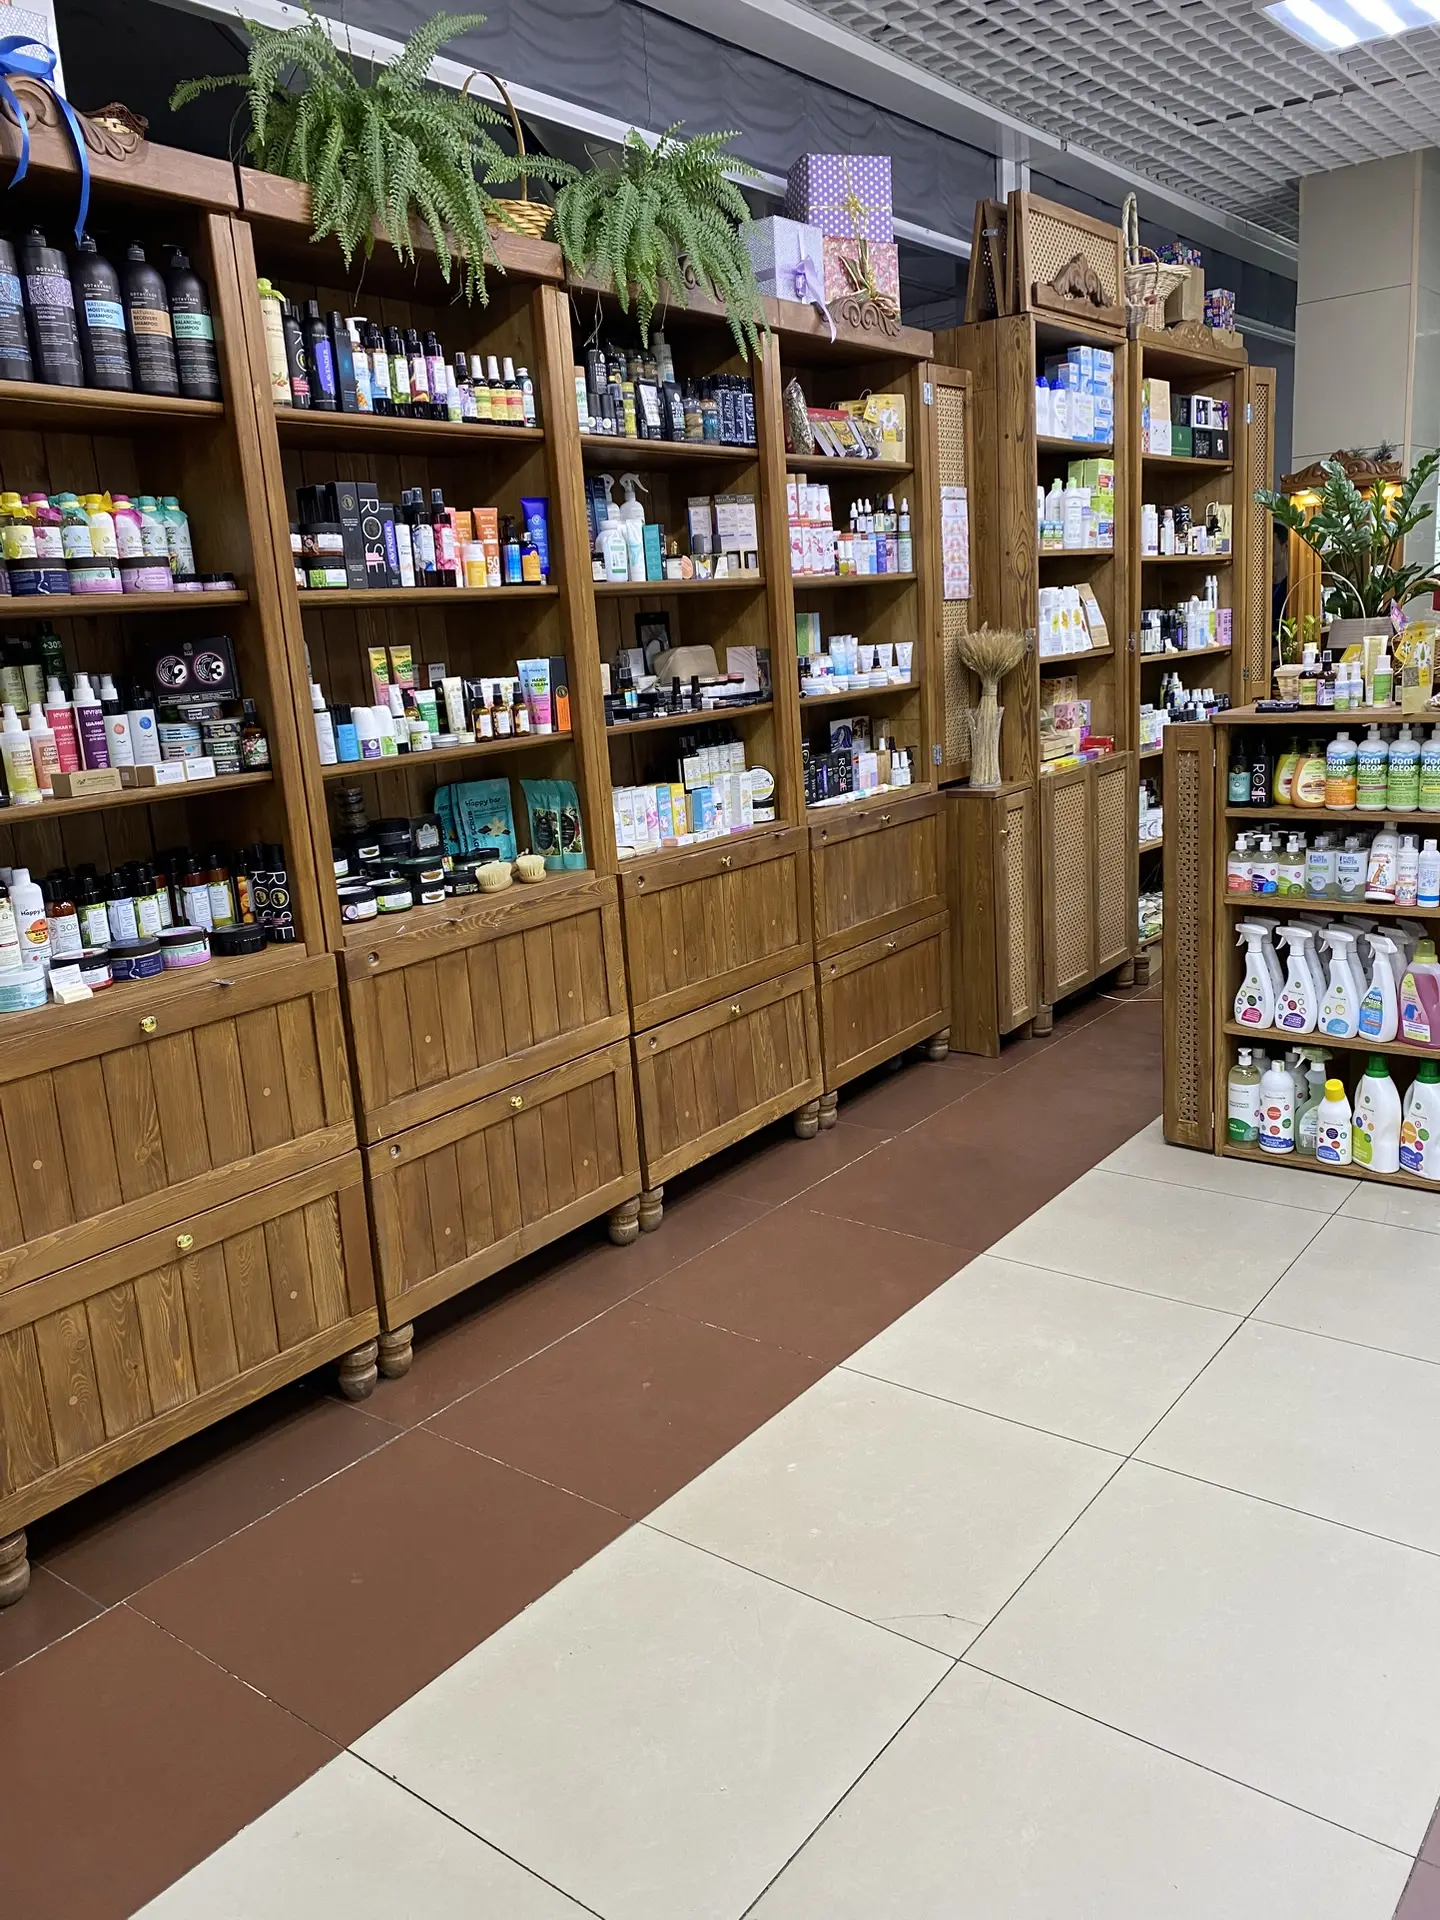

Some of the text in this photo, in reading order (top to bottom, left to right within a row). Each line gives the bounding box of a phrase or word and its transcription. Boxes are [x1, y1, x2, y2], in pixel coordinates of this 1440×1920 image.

[359, 498, 387, 573] ROSE
[386, 526, 396, 567] LAVENDER
[487, 556, 499, 568] 50
[174, 664, 187, 684] 2
[211, 661, 225, 680] 3
[838, 757, 847, 792] ROSE
[1357, 764, 1383, 772] detox
[1389, 764, 1416, 772] detox
[465, 799, 488, 808] Happy
[21, 909, 41, 917] Happy
